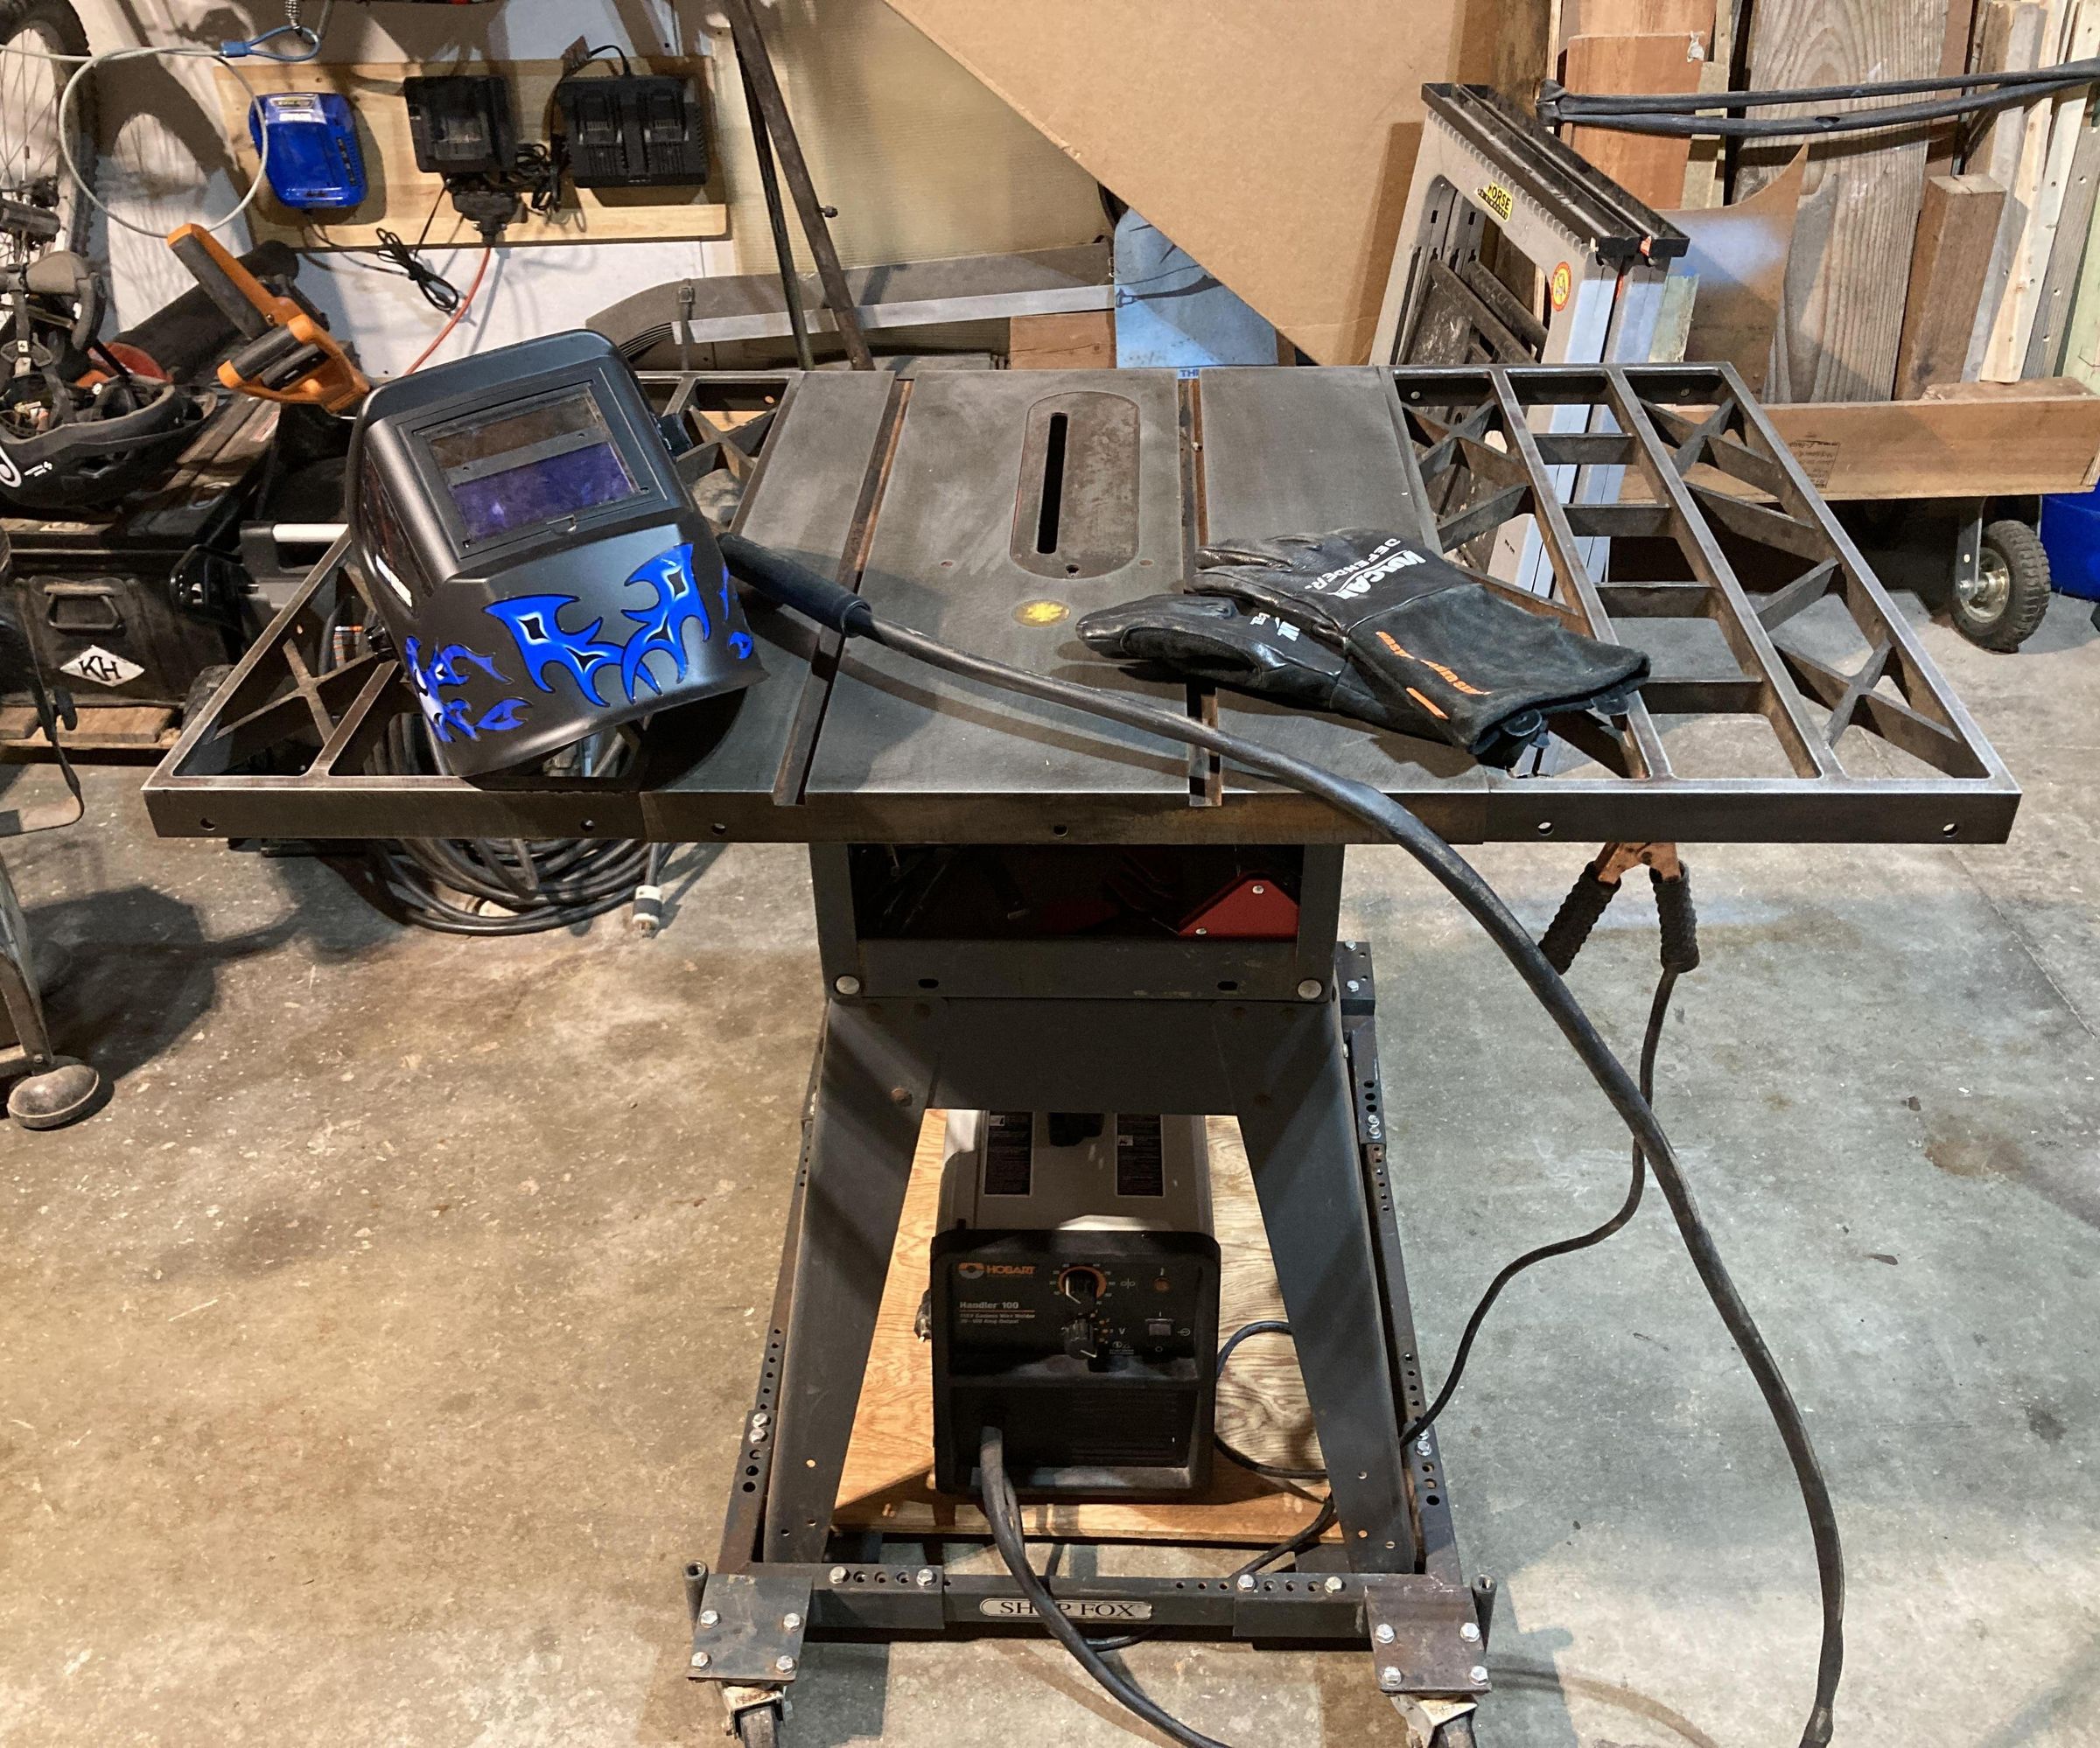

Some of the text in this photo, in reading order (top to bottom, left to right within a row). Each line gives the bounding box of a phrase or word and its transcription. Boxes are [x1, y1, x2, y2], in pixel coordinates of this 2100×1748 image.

[79, 655, 122, 682] KH
[985, 1265, 1036, 1275] HOBART
[1000, 1601, 1135, 1617] SHP FOX
